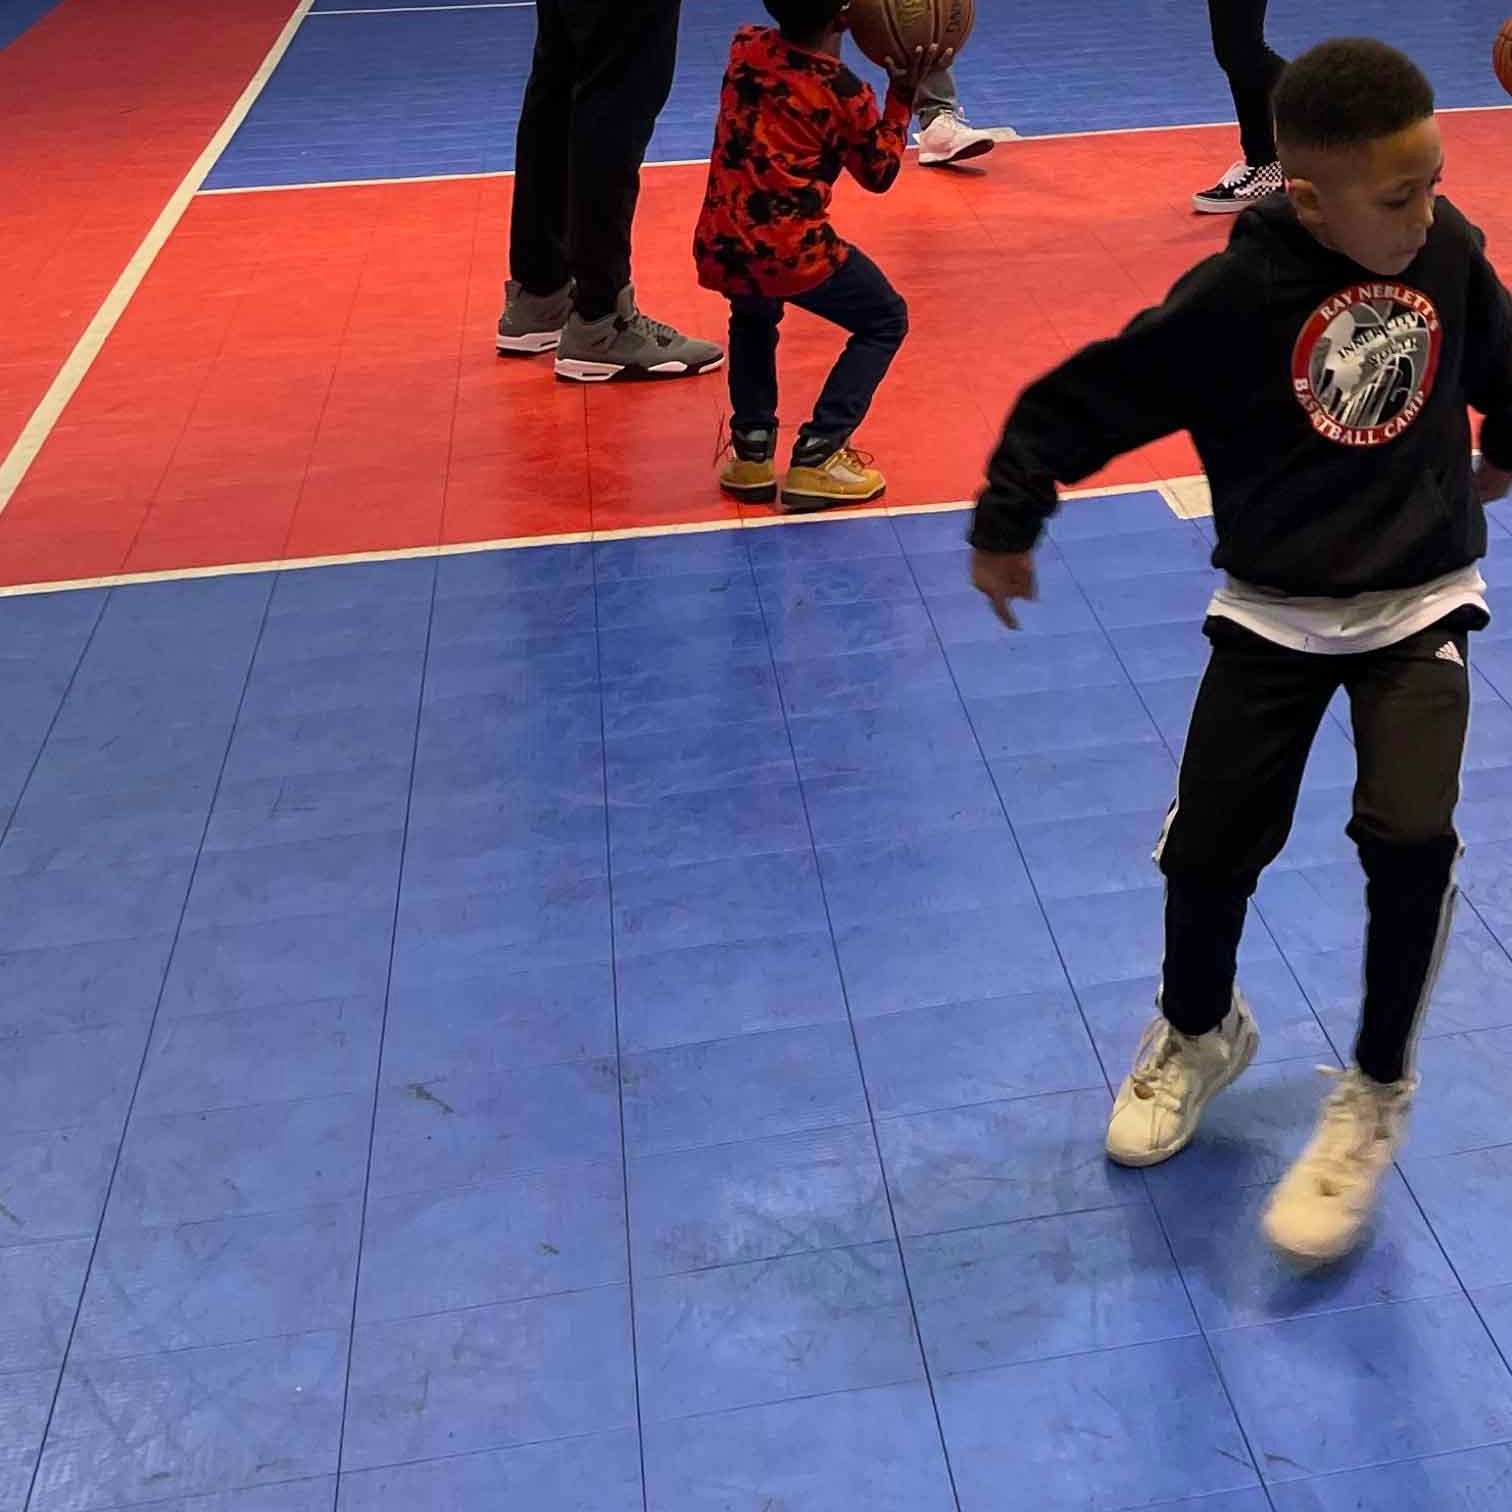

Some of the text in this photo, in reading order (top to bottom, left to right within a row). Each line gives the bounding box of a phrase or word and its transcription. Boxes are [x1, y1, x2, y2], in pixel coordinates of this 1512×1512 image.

[1320, 291, 1353, 321] RAY
[1294, 378, 1425, 445] BASKETBALL CAMP
